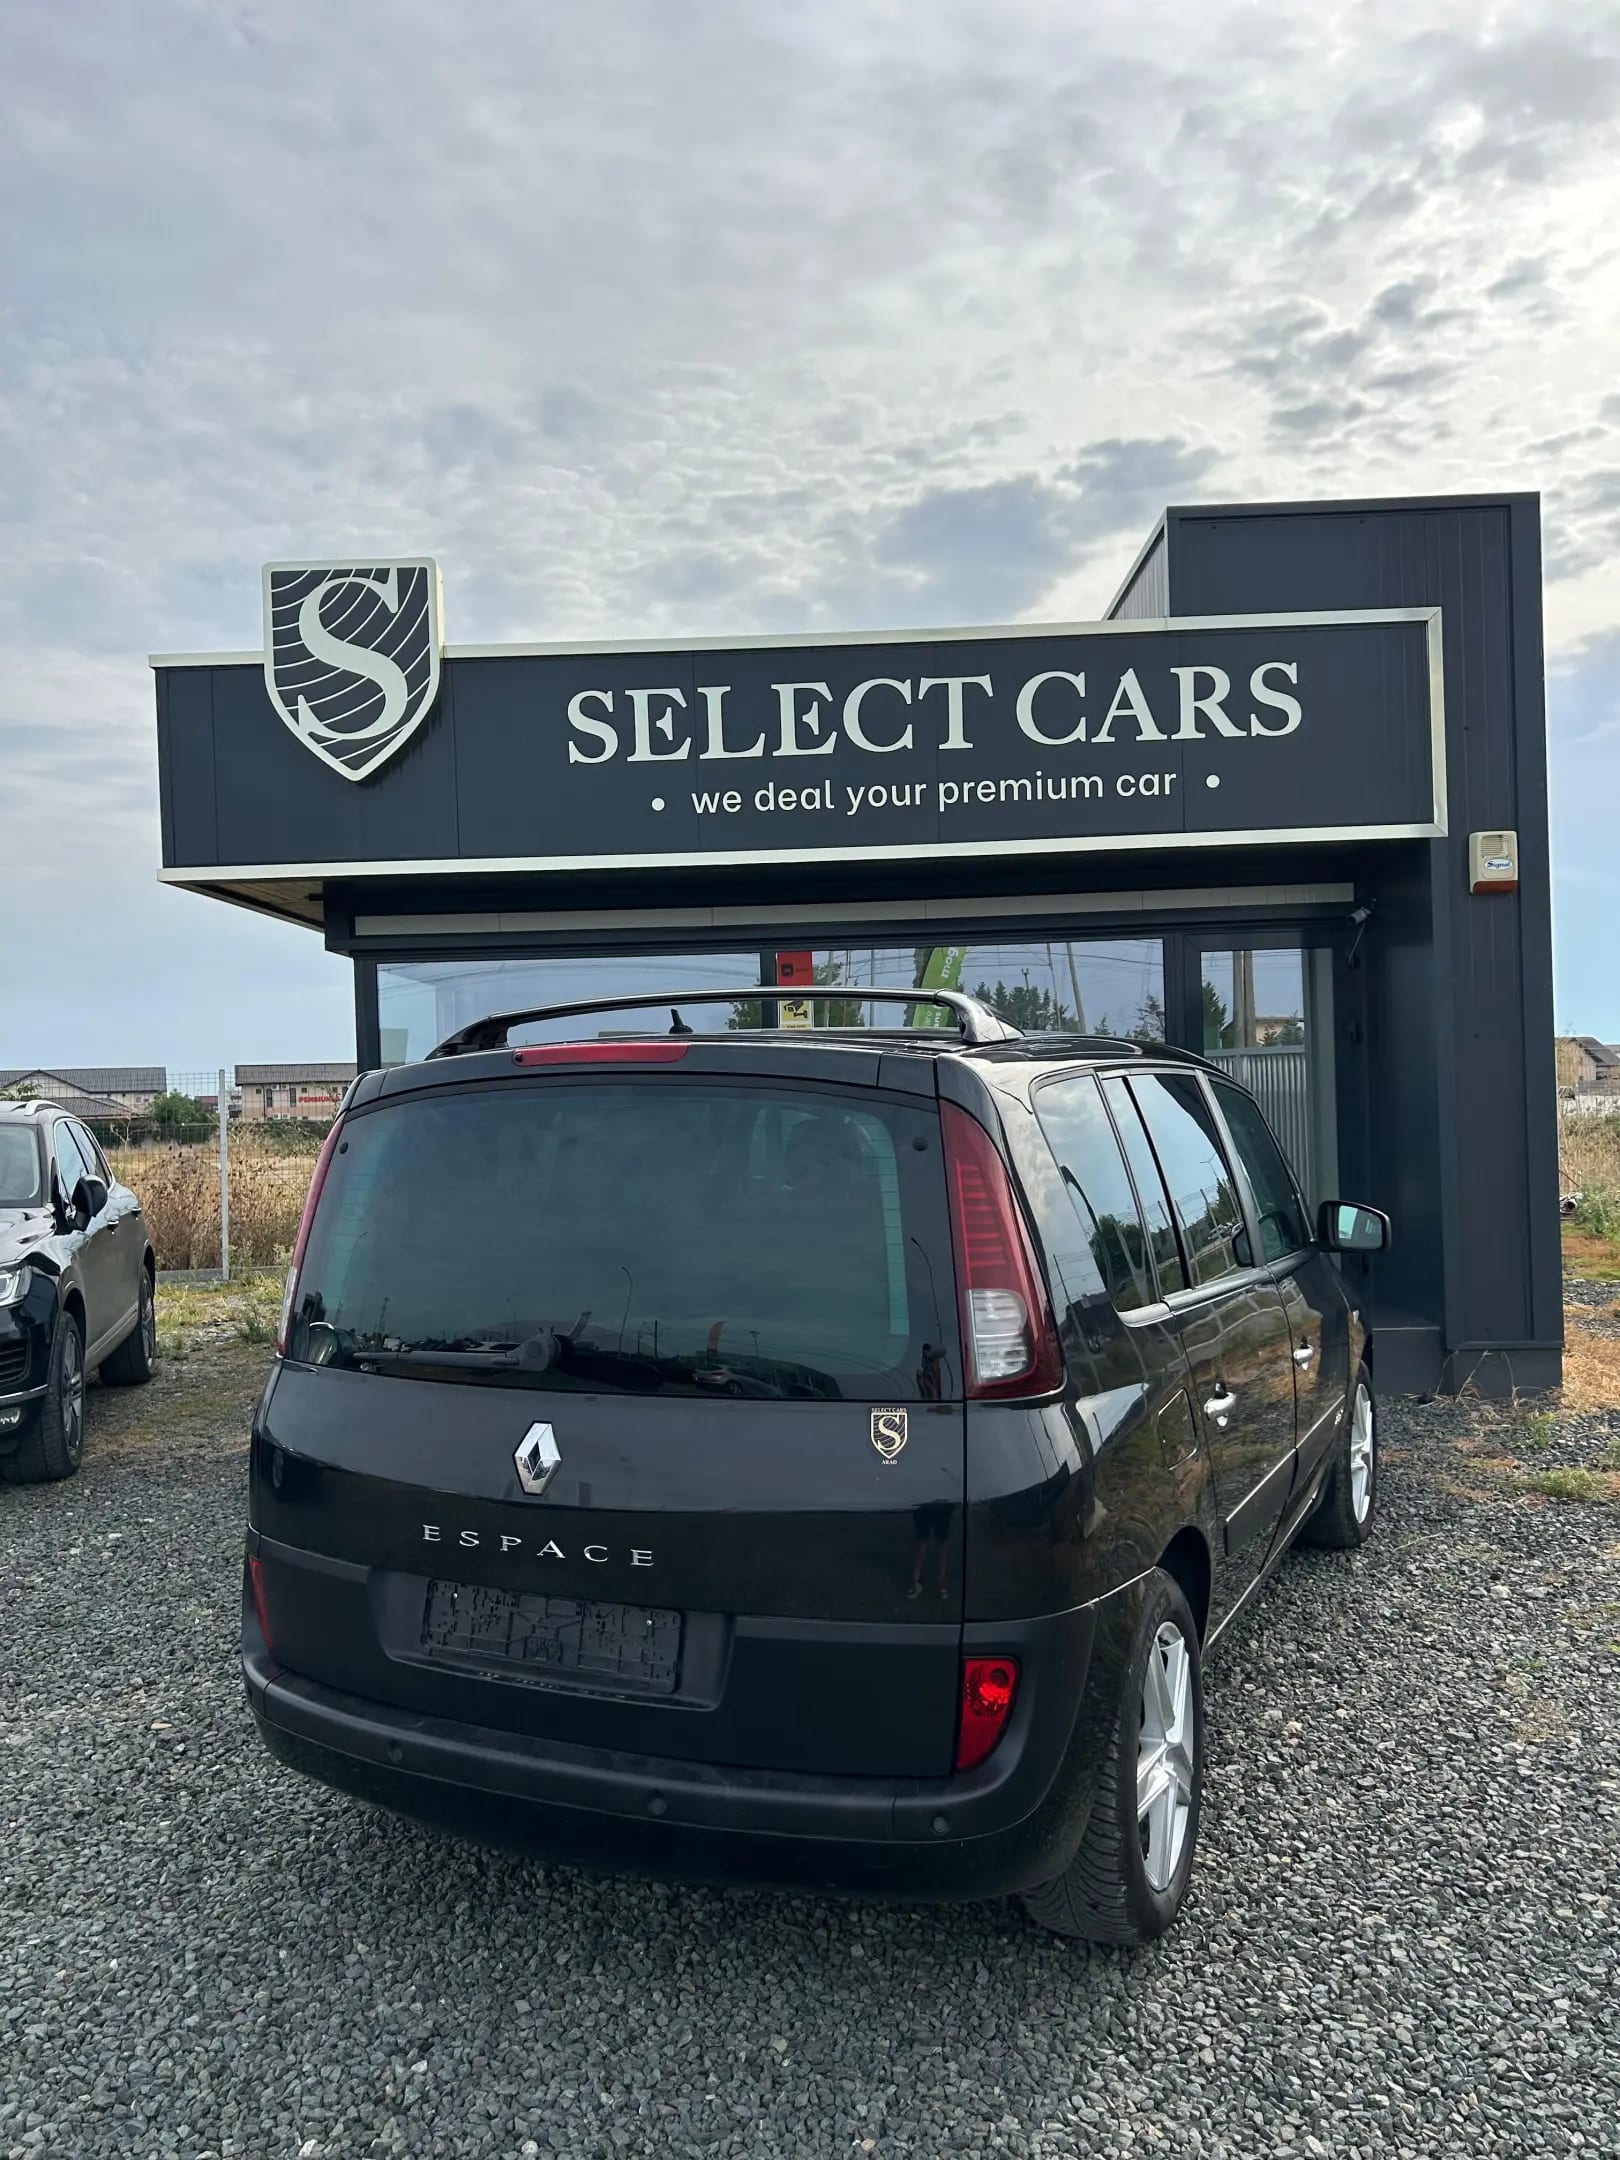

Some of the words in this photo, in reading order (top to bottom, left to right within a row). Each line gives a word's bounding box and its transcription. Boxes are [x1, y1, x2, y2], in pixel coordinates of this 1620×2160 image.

[299, 570, 408, 740] S
[568, 674, 994, 764] SELECT
[1016, 662, 1302, 745] CARS
[691, 790, 742, 814] we
[754, 779, 835, 812] deal
[846, 783, 927, 816] your
[938, 770, 1104, 813] premium
[1116, 773, 1177, 797] car
[1487, 860, 1511, 870] Signal
[877, 1415, 901, 1450] S
[422, 1524, 654, 1567] ESPACE
